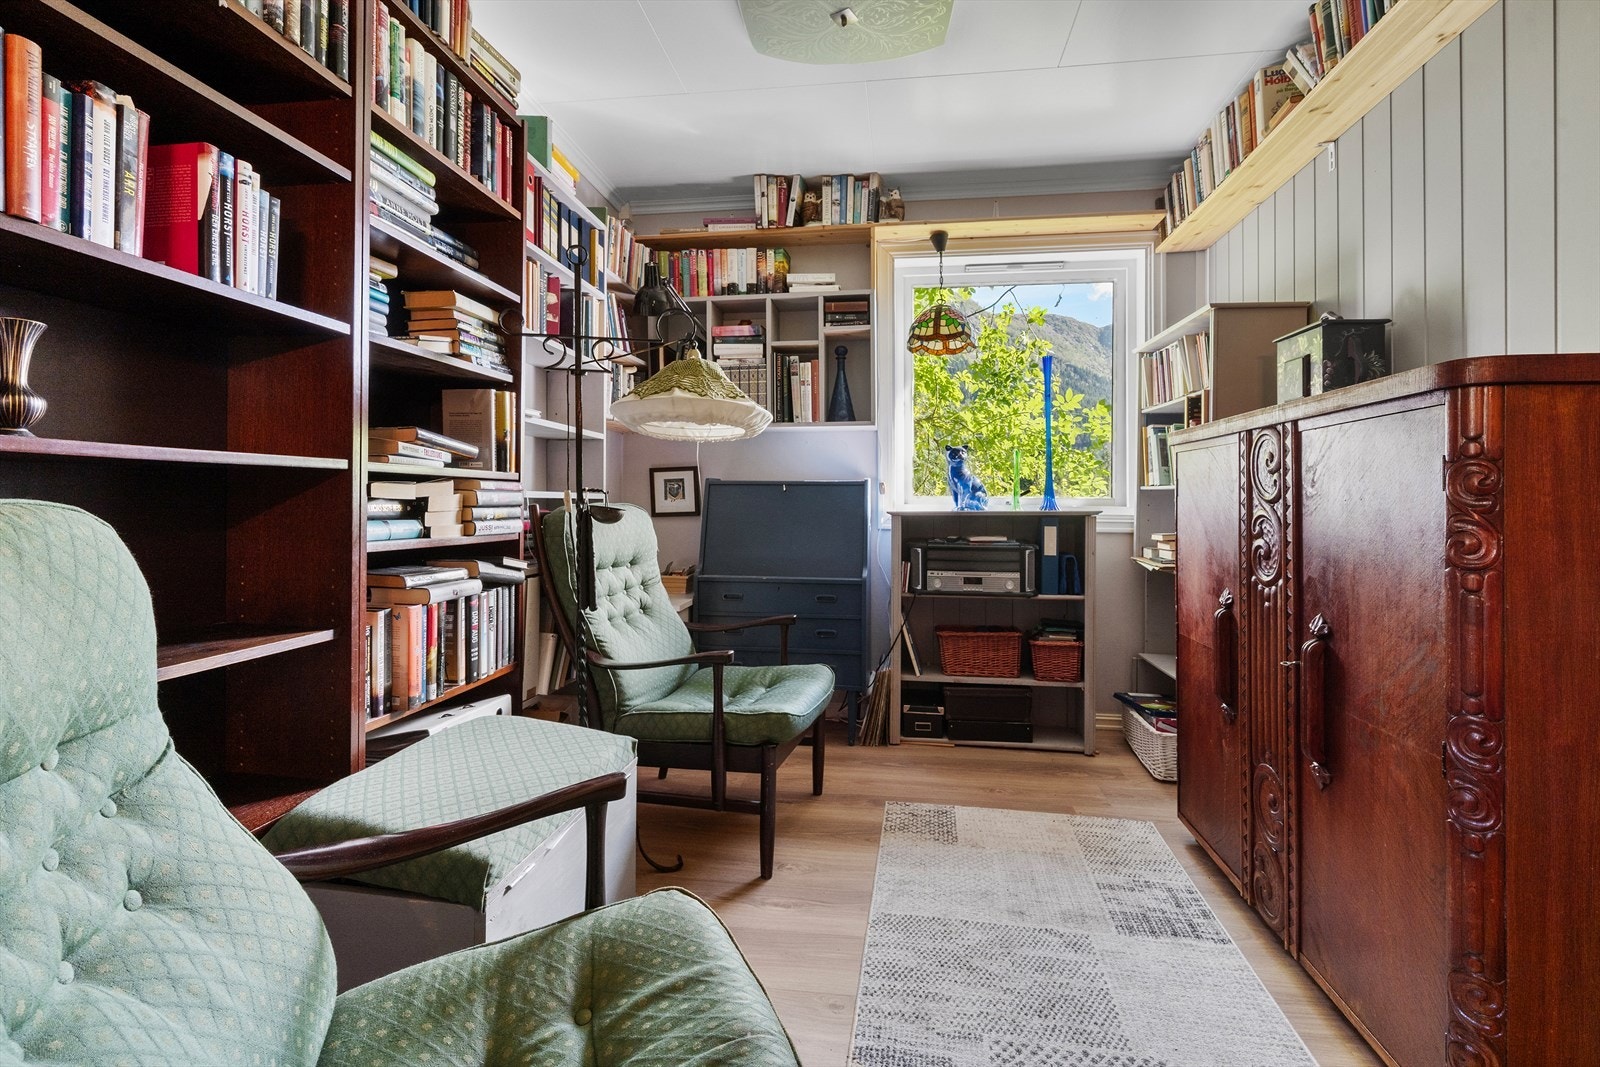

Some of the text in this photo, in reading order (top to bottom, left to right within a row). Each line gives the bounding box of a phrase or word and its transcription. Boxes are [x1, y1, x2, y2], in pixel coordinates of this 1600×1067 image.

[23, 120, 38, 170] STRAFFEN
[123, 170, 136, 197] ARR
[223, 202, 233, 238] HORST
[241, 210, 250, 245] HORST
[259, 230, 268, 259] HORST
[268, 231, 276, 259] HORST
